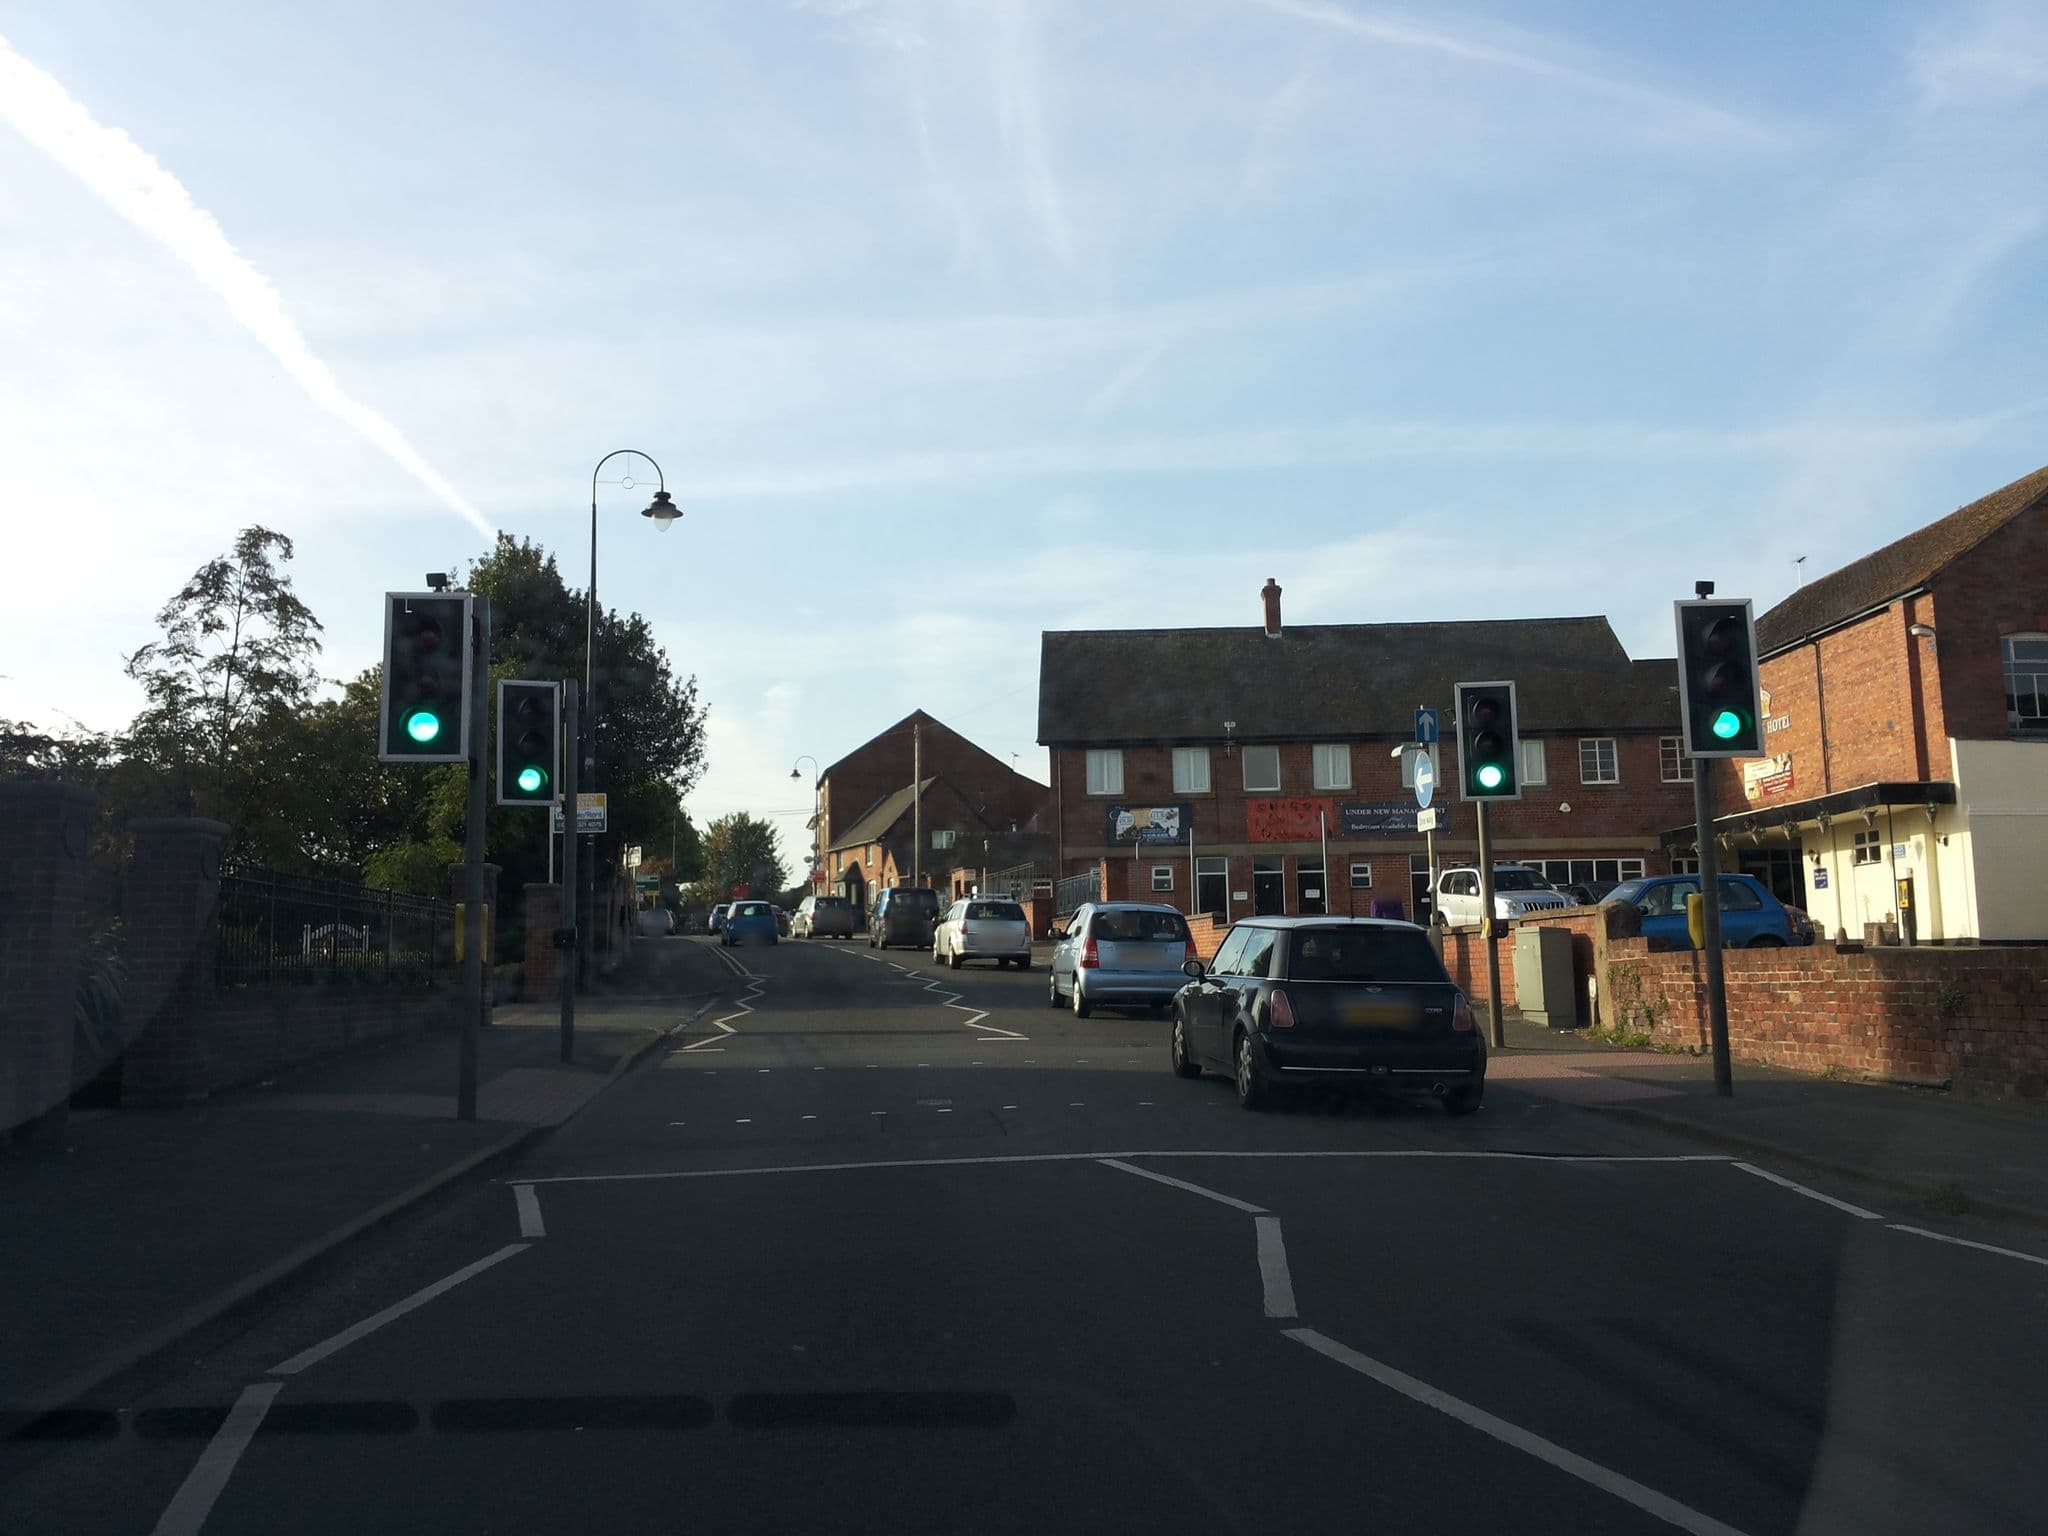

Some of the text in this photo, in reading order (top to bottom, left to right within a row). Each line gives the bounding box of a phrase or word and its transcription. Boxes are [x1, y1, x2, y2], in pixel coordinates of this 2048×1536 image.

[1766, 715, 1791, 734] HOTEL
[1373, 807, 1391, 815] NEW
[1392, 807, 1446, 815] MANAGNT
